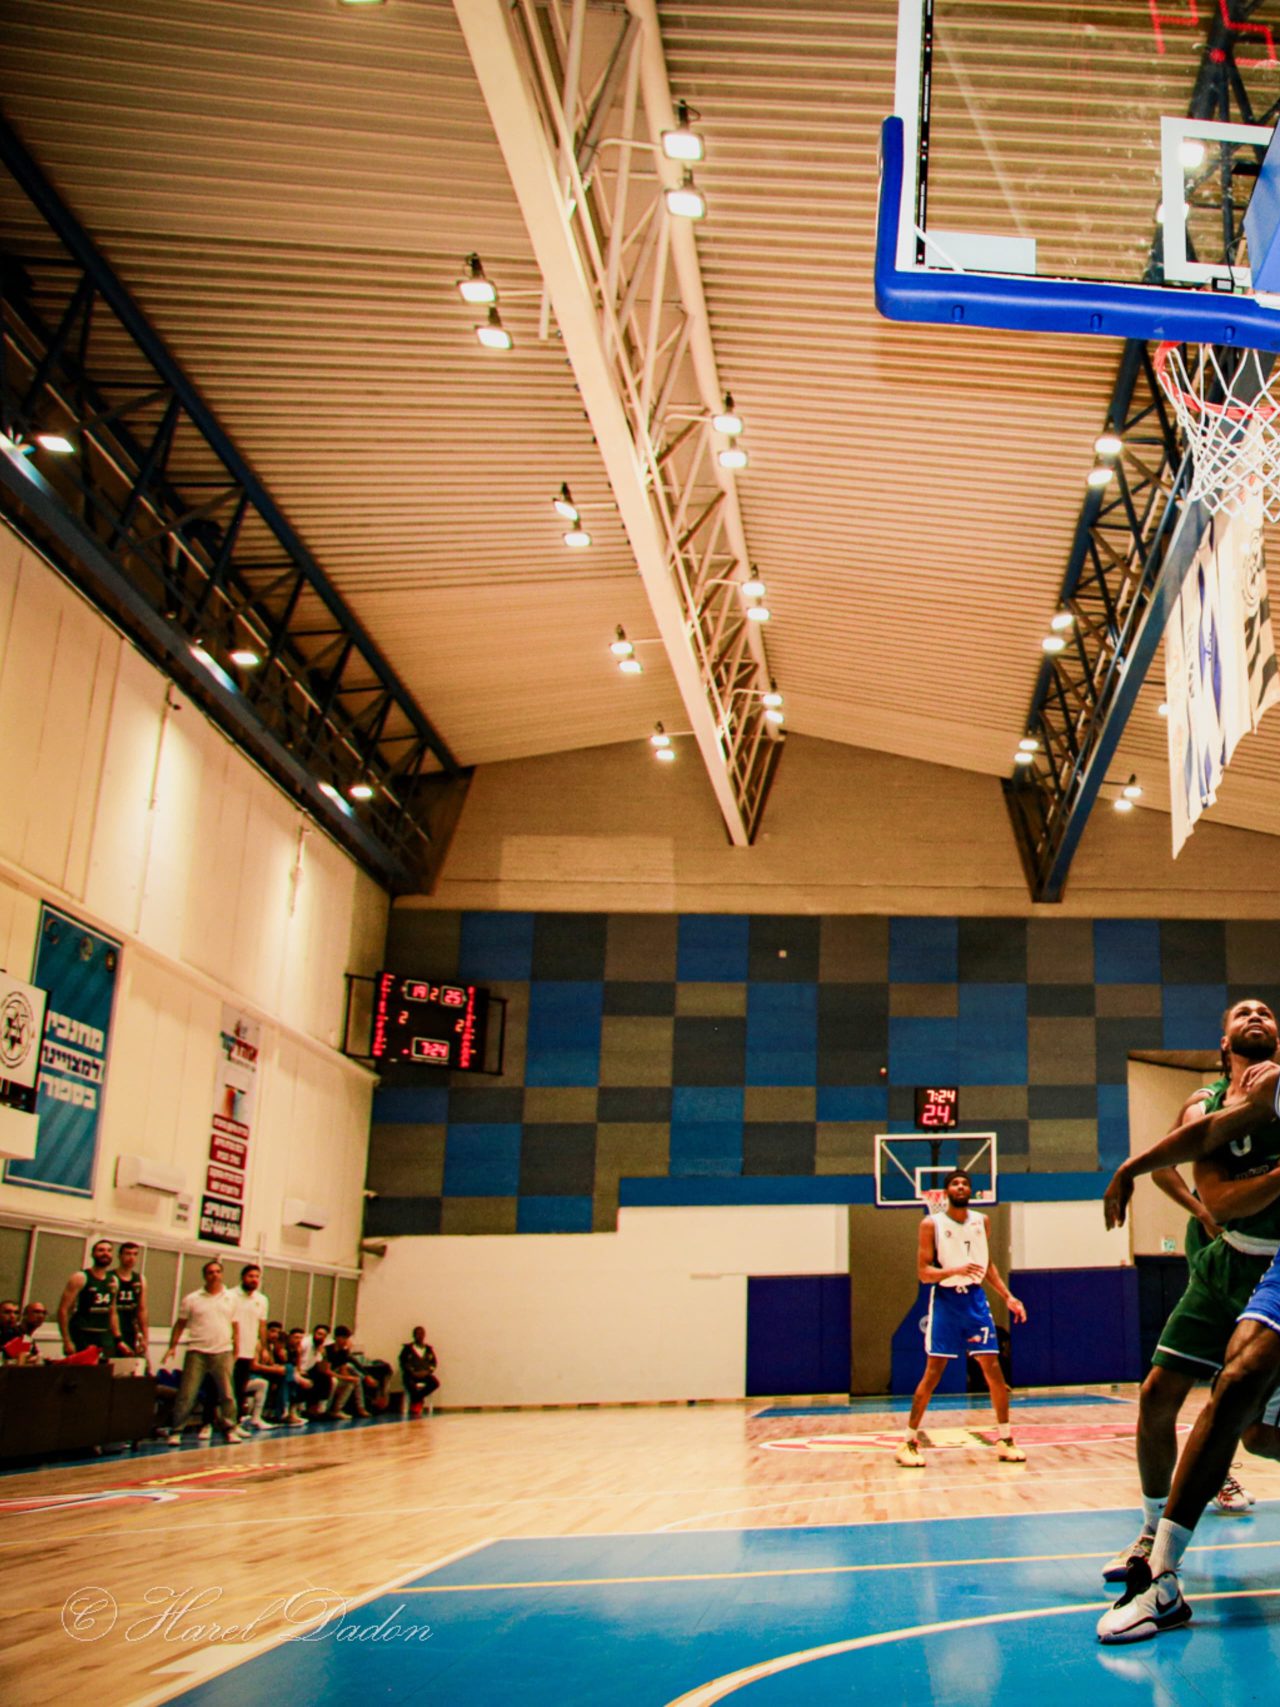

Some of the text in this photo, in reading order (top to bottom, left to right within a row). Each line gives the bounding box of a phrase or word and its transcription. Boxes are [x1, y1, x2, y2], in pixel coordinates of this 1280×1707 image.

[46, 1010, 104, 1052] מחנכי
[398, 1010, 465, 1033] 2 2
[43, 1045, 101, 1080] למצויינו
[39, 1072, 96, 1110] בספור
[926, 1089, 956, 1104] 7:24
[963, 1240, 971, 1257] 7
[980, 1326, 989, 1345] 7
